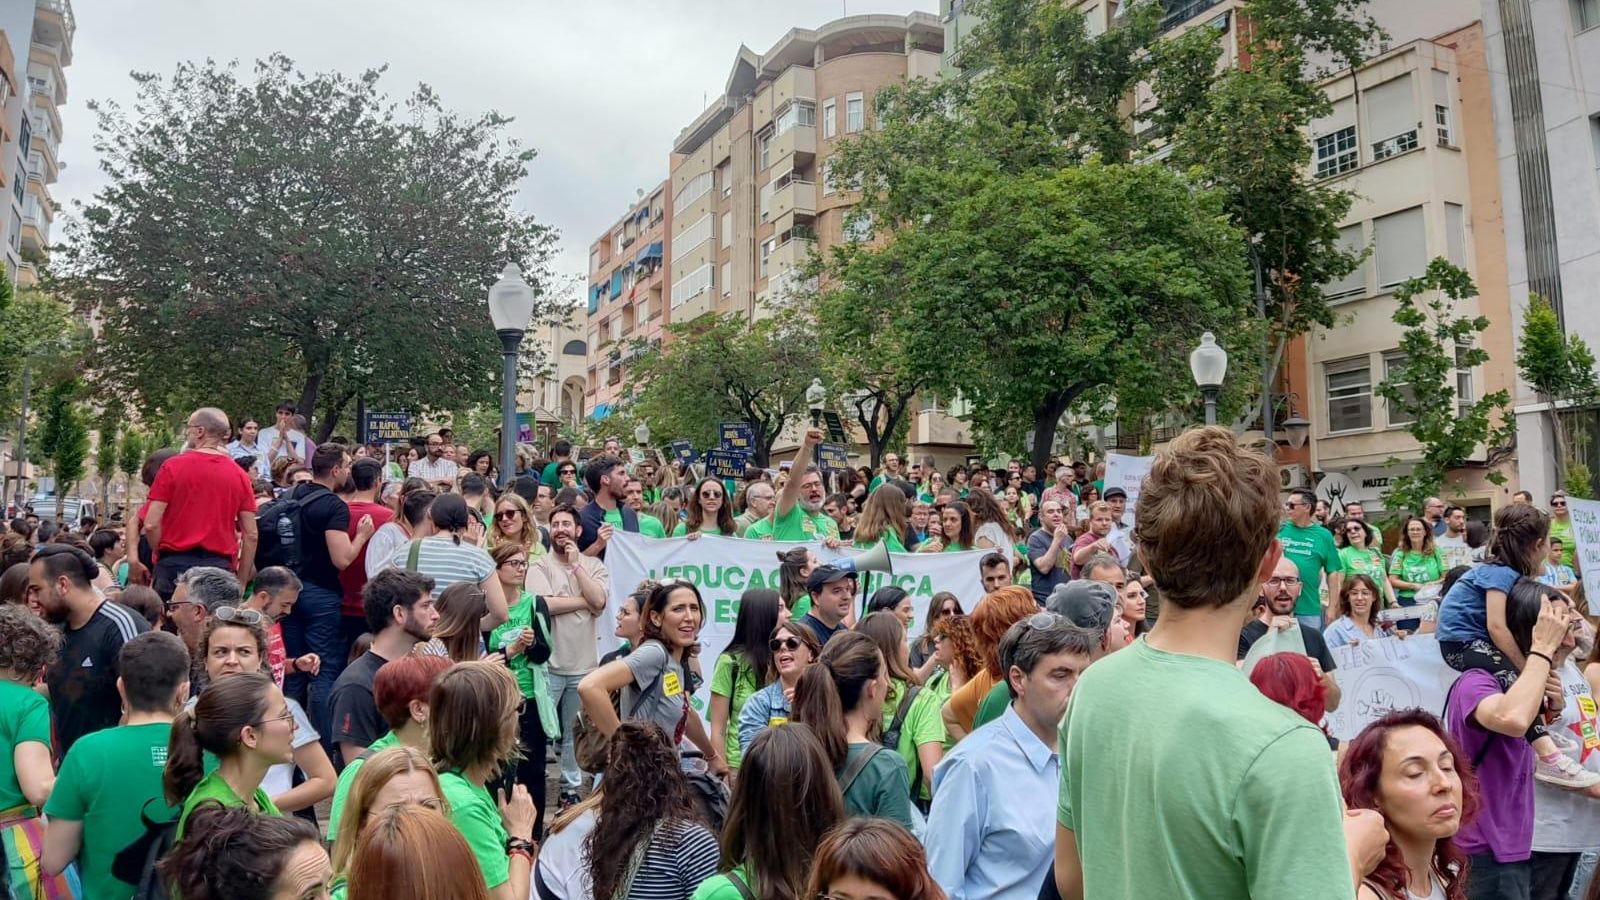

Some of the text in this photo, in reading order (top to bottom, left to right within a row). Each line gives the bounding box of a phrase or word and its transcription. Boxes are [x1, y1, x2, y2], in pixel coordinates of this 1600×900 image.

[369, 419, 400, 430] EL RÁFOL
[709, 457, 732, 468] LA VALL
